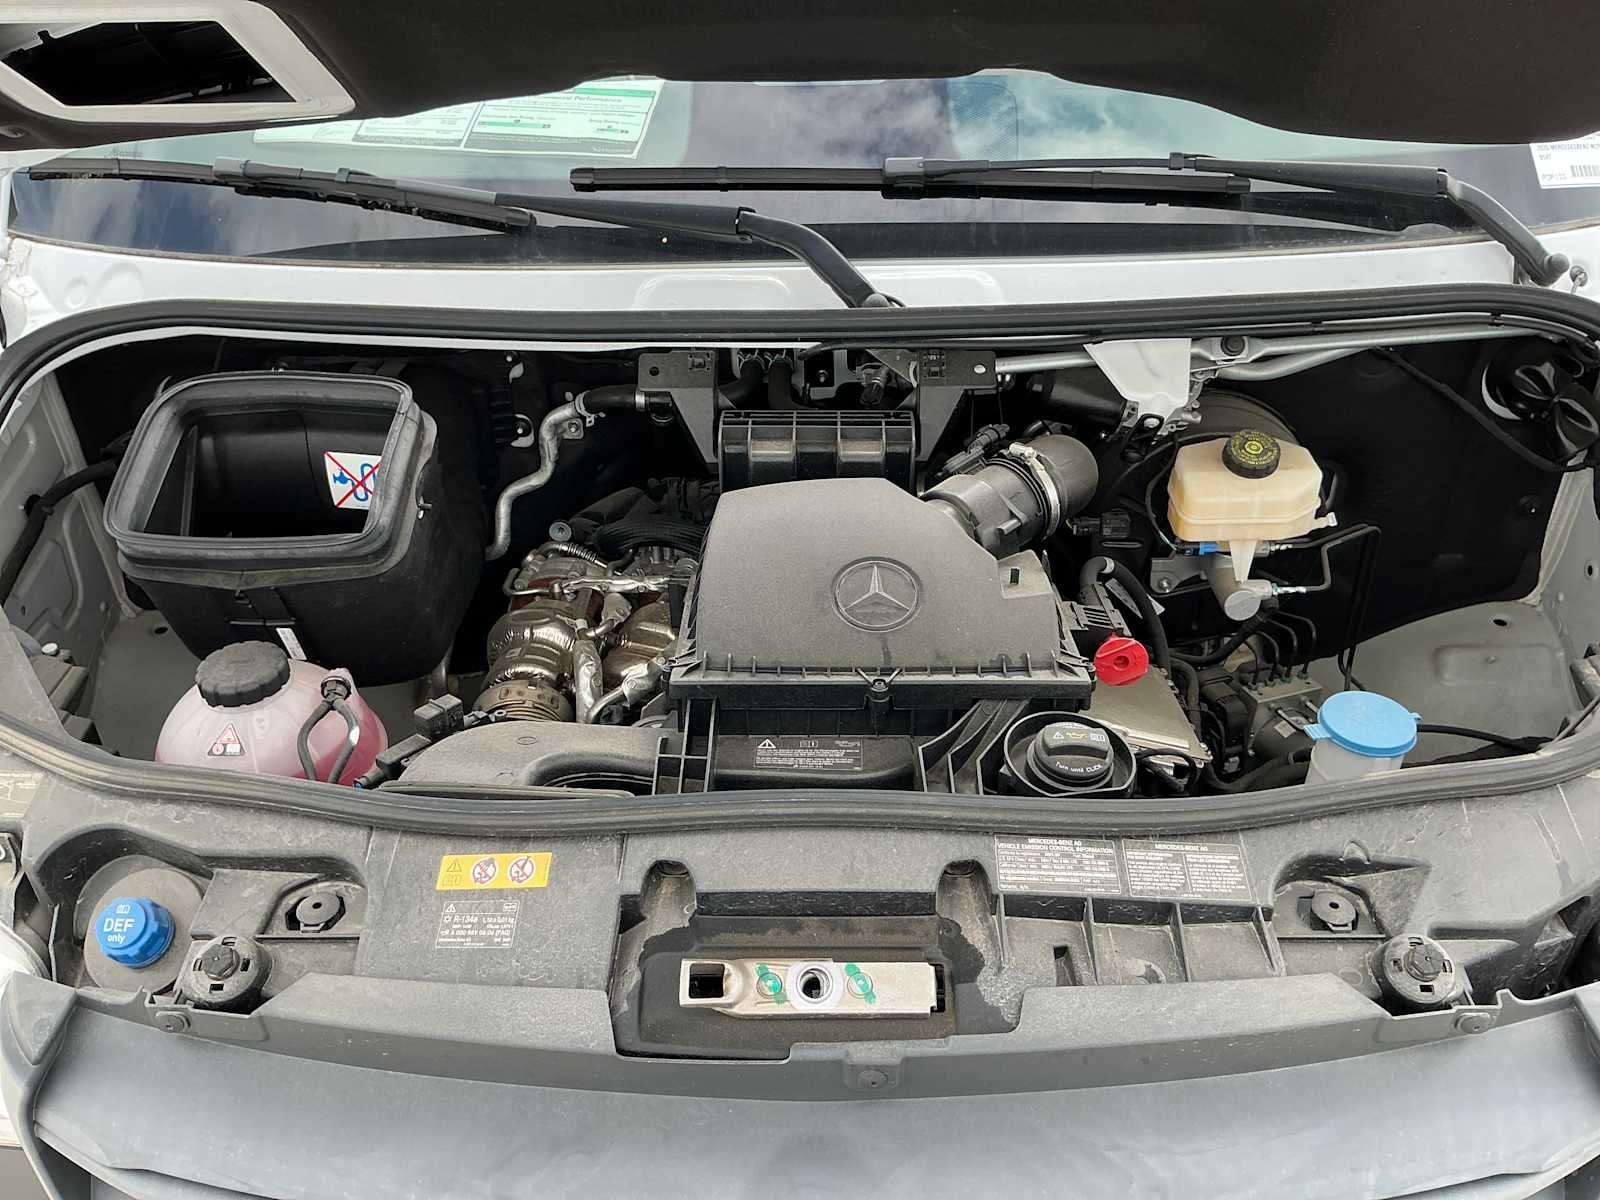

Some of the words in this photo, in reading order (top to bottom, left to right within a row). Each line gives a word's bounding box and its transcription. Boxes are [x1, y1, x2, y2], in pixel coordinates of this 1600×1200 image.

[1055, 761, 1069, 770] Turn
[1086, 764, 1104, 773] CLICK
[997, 842, 1020, 850] VEHICLE
[1021, 843, 1048, 851] EMISSION
[1027, 838, 1073, 846] MERCEDES-BENZ
[1154, 843, 1199, 851] MERCEDES-BENZ
[103, 917, 135, 932] DEF
[107, 933, 126, 945] only
